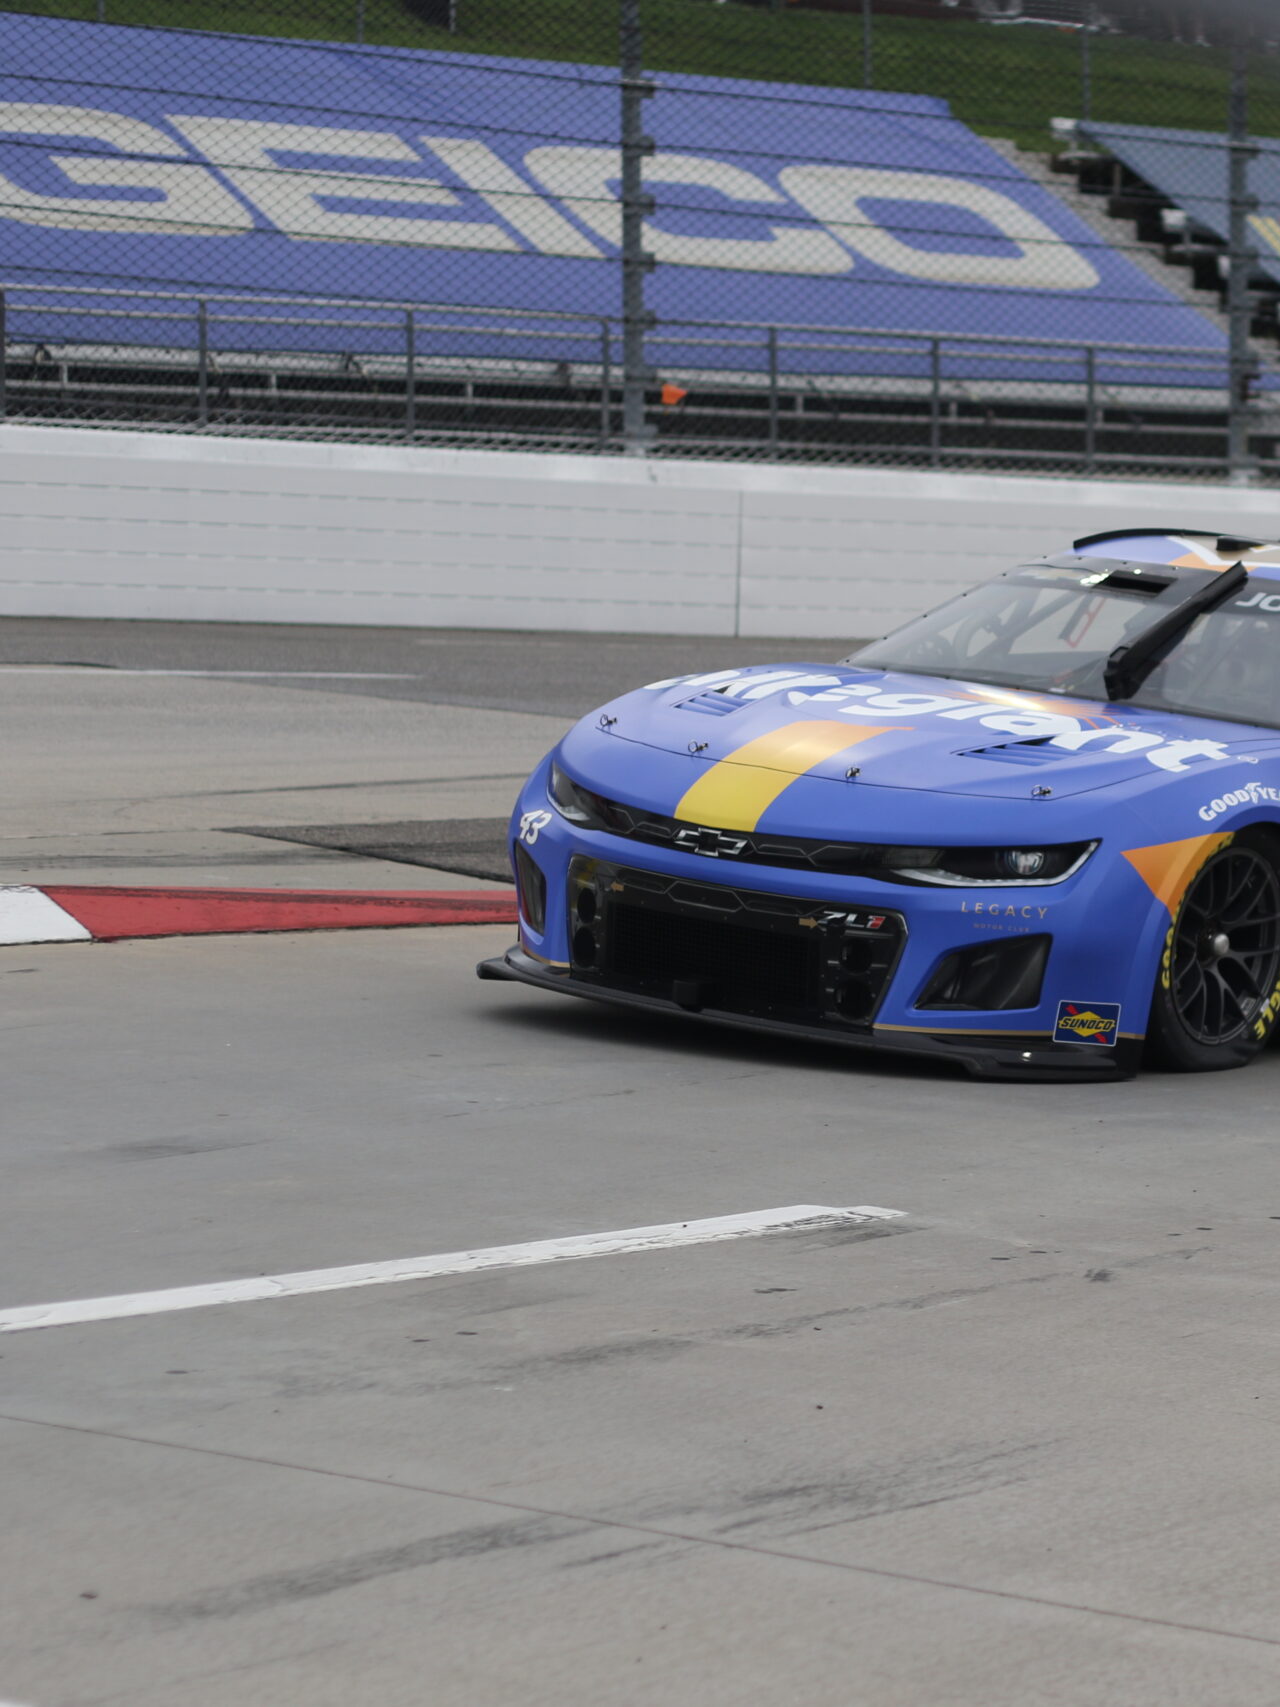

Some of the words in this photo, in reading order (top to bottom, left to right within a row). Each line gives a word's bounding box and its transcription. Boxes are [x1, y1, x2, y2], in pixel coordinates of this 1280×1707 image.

[0, 102, 1100, 290] GEICO
[519, 809, 553, 846] 43
[960, 901, 1048, 919] LEGACY
[973, 922, 1003, 931] MOTOR
[1008, 924, 1030, 933] CLUB
[1060, 1017, 1114, 1031] SUNOCO
